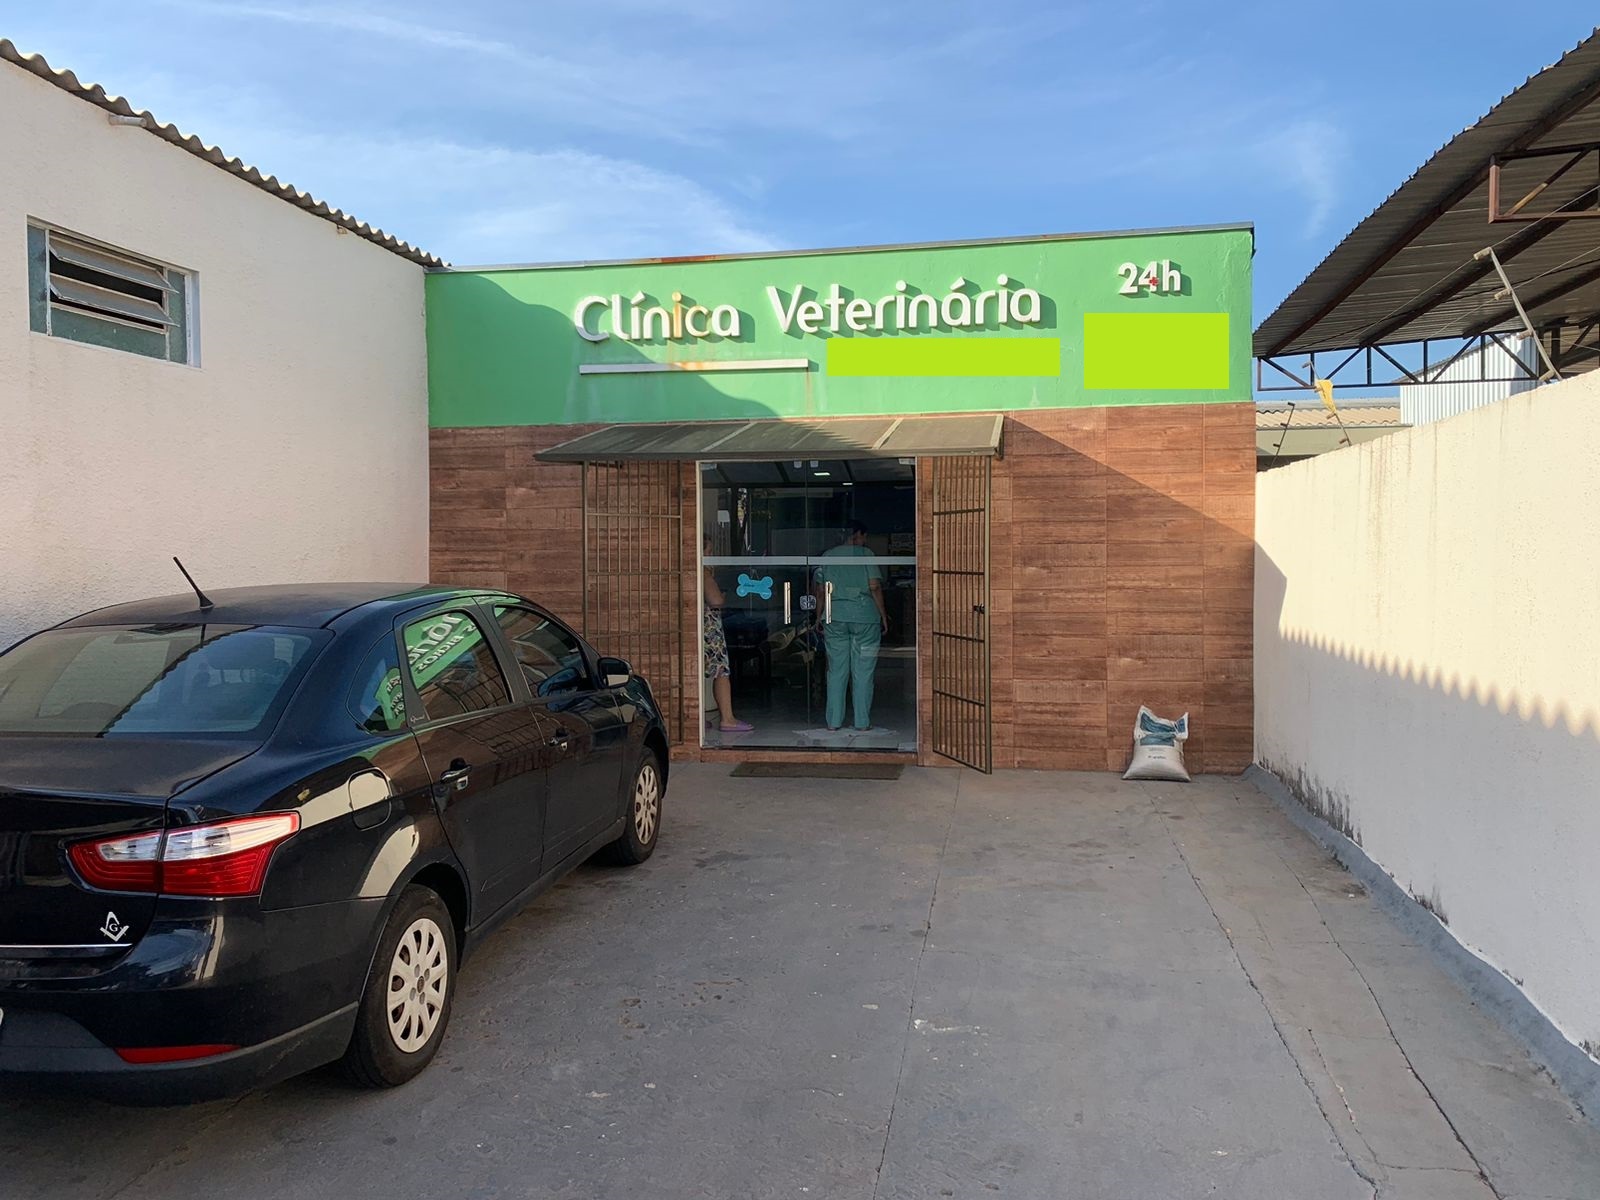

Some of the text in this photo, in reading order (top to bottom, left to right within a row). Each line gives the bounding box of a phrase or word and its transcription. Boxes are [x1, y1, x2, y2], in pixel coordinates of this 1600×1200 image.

[1118, 259, 1182, 295] 24h
[573, 274, 1042, 342] Clínica Veterinária
[109, 923, 118, 932] G
